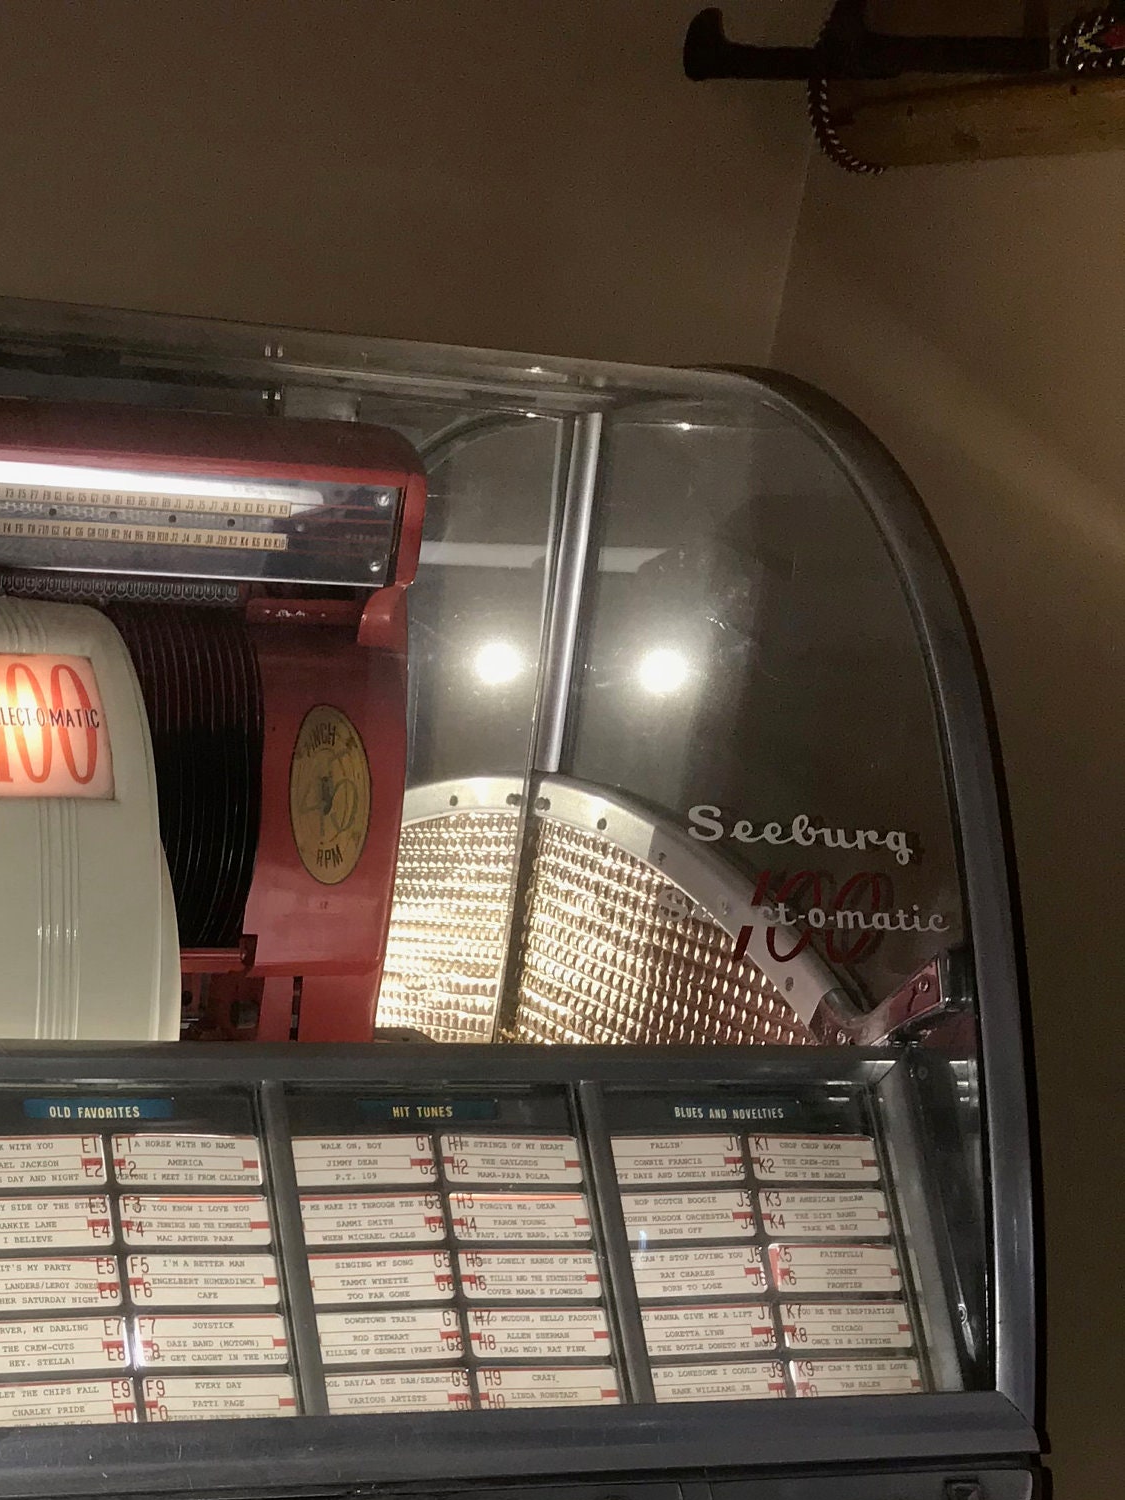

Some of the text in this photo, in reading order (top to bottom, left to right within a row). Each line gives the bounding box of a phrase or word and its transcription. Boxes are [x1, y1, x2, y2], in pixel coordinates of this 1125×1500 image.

[687, 804, 913, 866] Seeburg
[317, 845, 343, 869] RPM
[732, 869, 881, 964] 100
[49, 1105, 140, 1119] OLD FAVORITES
[392, 1106, 453, 1118] HIT TUNES
[675, 1106, 784, 1120] BLUES AND NOVELTIES
[36, 1142, 53, 1150] YOU
[20, 1160, 59, 1168] JACKSON
[167, 1159, 203, 1167] AMERICA
[326, 1159, 352, 1167] JIMMY
[634, 1158, 665, 1166] CONNIE
[764, 1192, 782, 1206] K3
[131, 1257, 149, 1273] F5
[680, 1270, 715, 1278] CHARLES
[340, 1276, 409, 1287] TAMMY WYNETTE
[662, 1284, 684, 1292] BORN
[687, 1283, 698, 1291] TO
[344, 1315, 417, 1324] DOWNTOWN TRAIN
[32, 1325, 45, 1333] MY
[49, 1324, 89, 1332] DARLING
[353, 1333, 409, 1342] ROD STEWART
[665, 1330, 701, 1338] LORETTA
[484, 1370, 502, 1386] H9
[111, 1381, 131, 1397] E9
[511, 1390, 578, 1399] LINDA RONSTADT
[222, 1399, 245, 1407] PAGE
